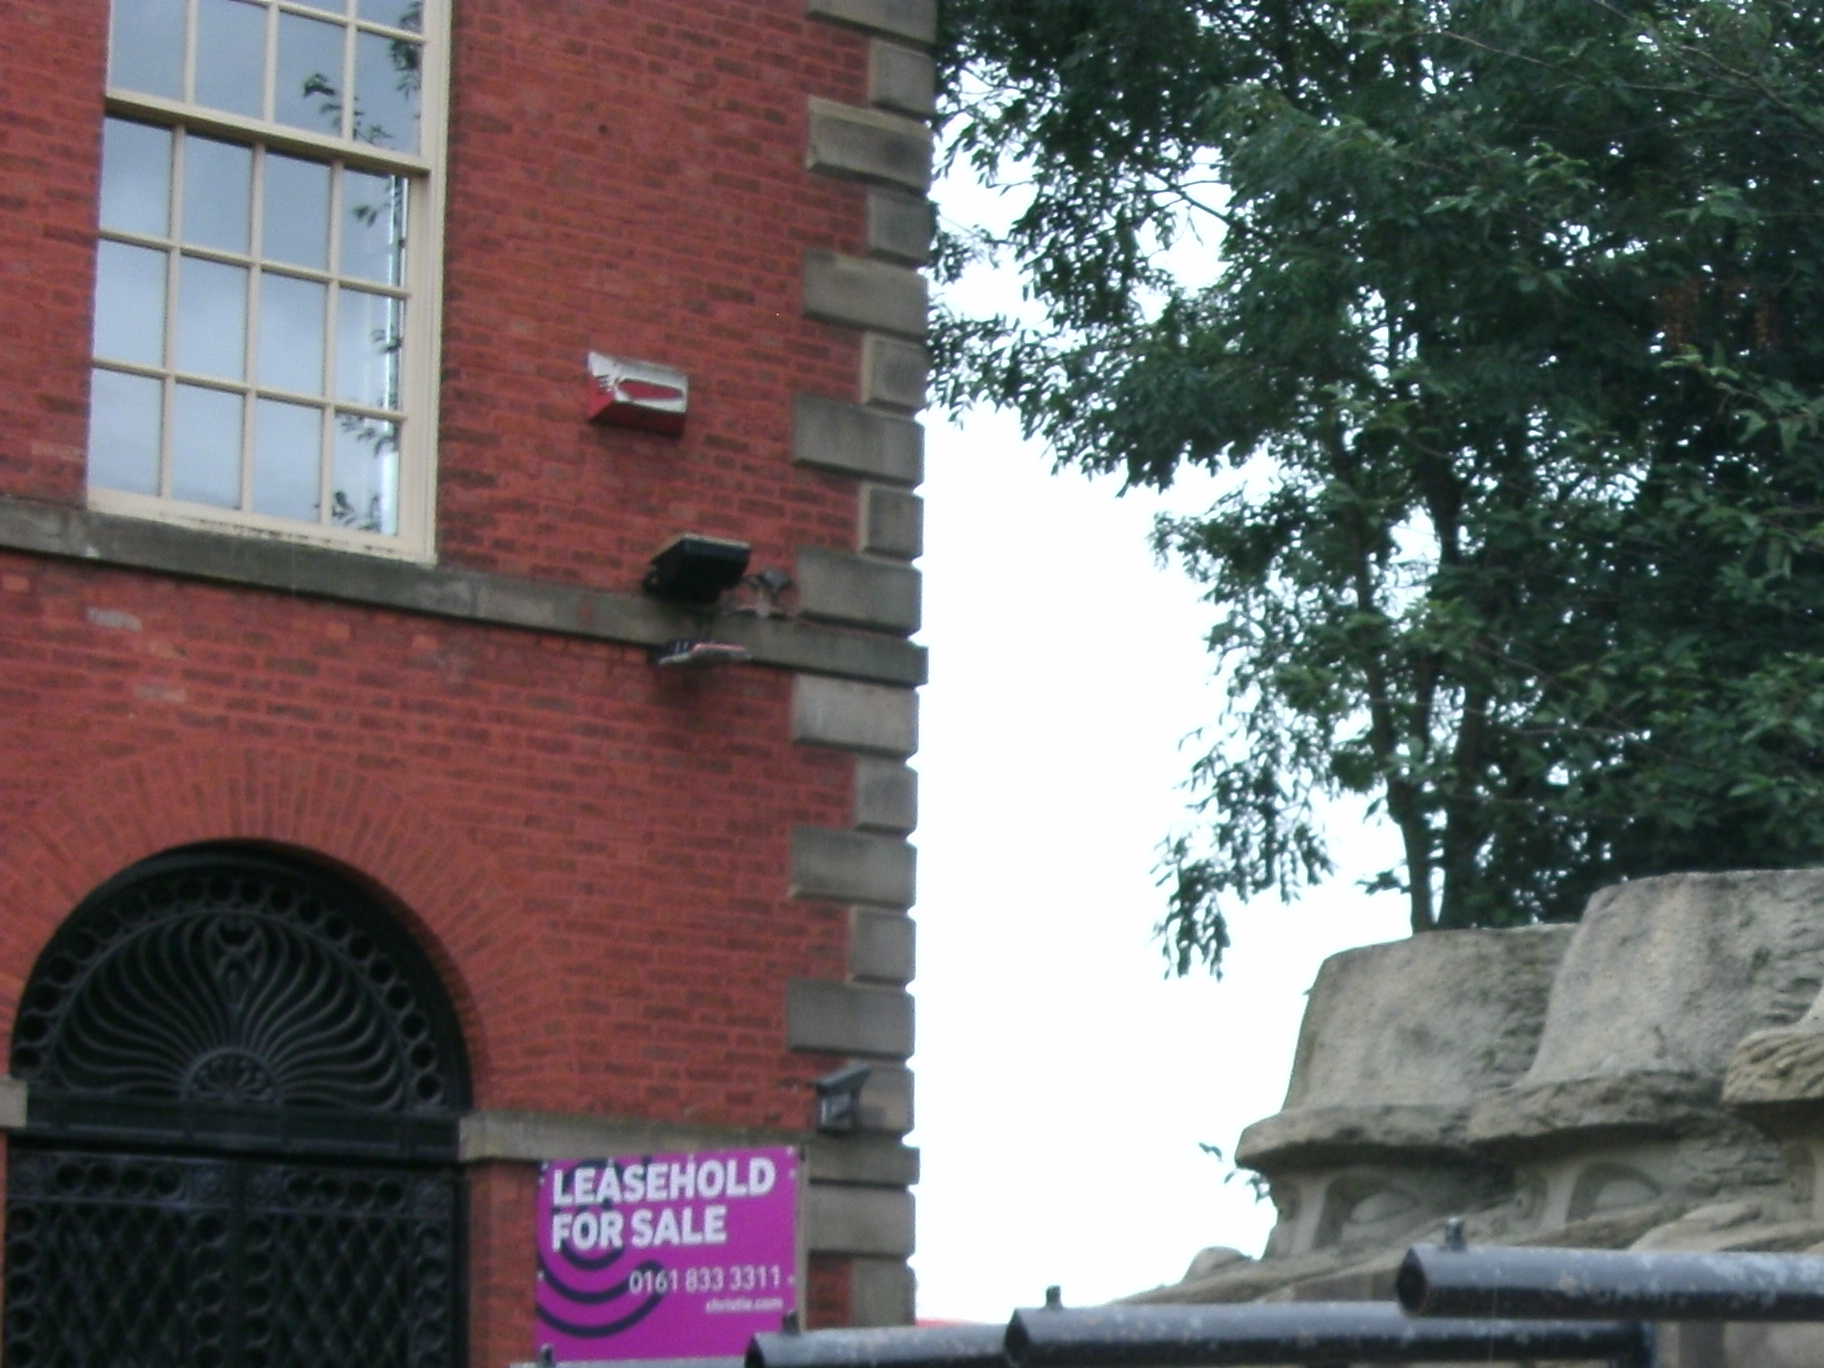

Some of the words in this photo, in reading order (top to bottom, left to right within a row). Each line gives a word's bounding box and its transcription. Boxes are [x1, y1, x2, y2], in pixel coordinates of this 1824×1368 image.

[552, 1157, 776, 1206] LEASEHOLD
[552, 1210, 624, 1251] FOR
[630, 1204, 728, 1247] SALE
[628, 1268, 678, 1294] 0161
[685, 1266, 724, 1292] 833
[730, 1264, 781, 1291] 3311
